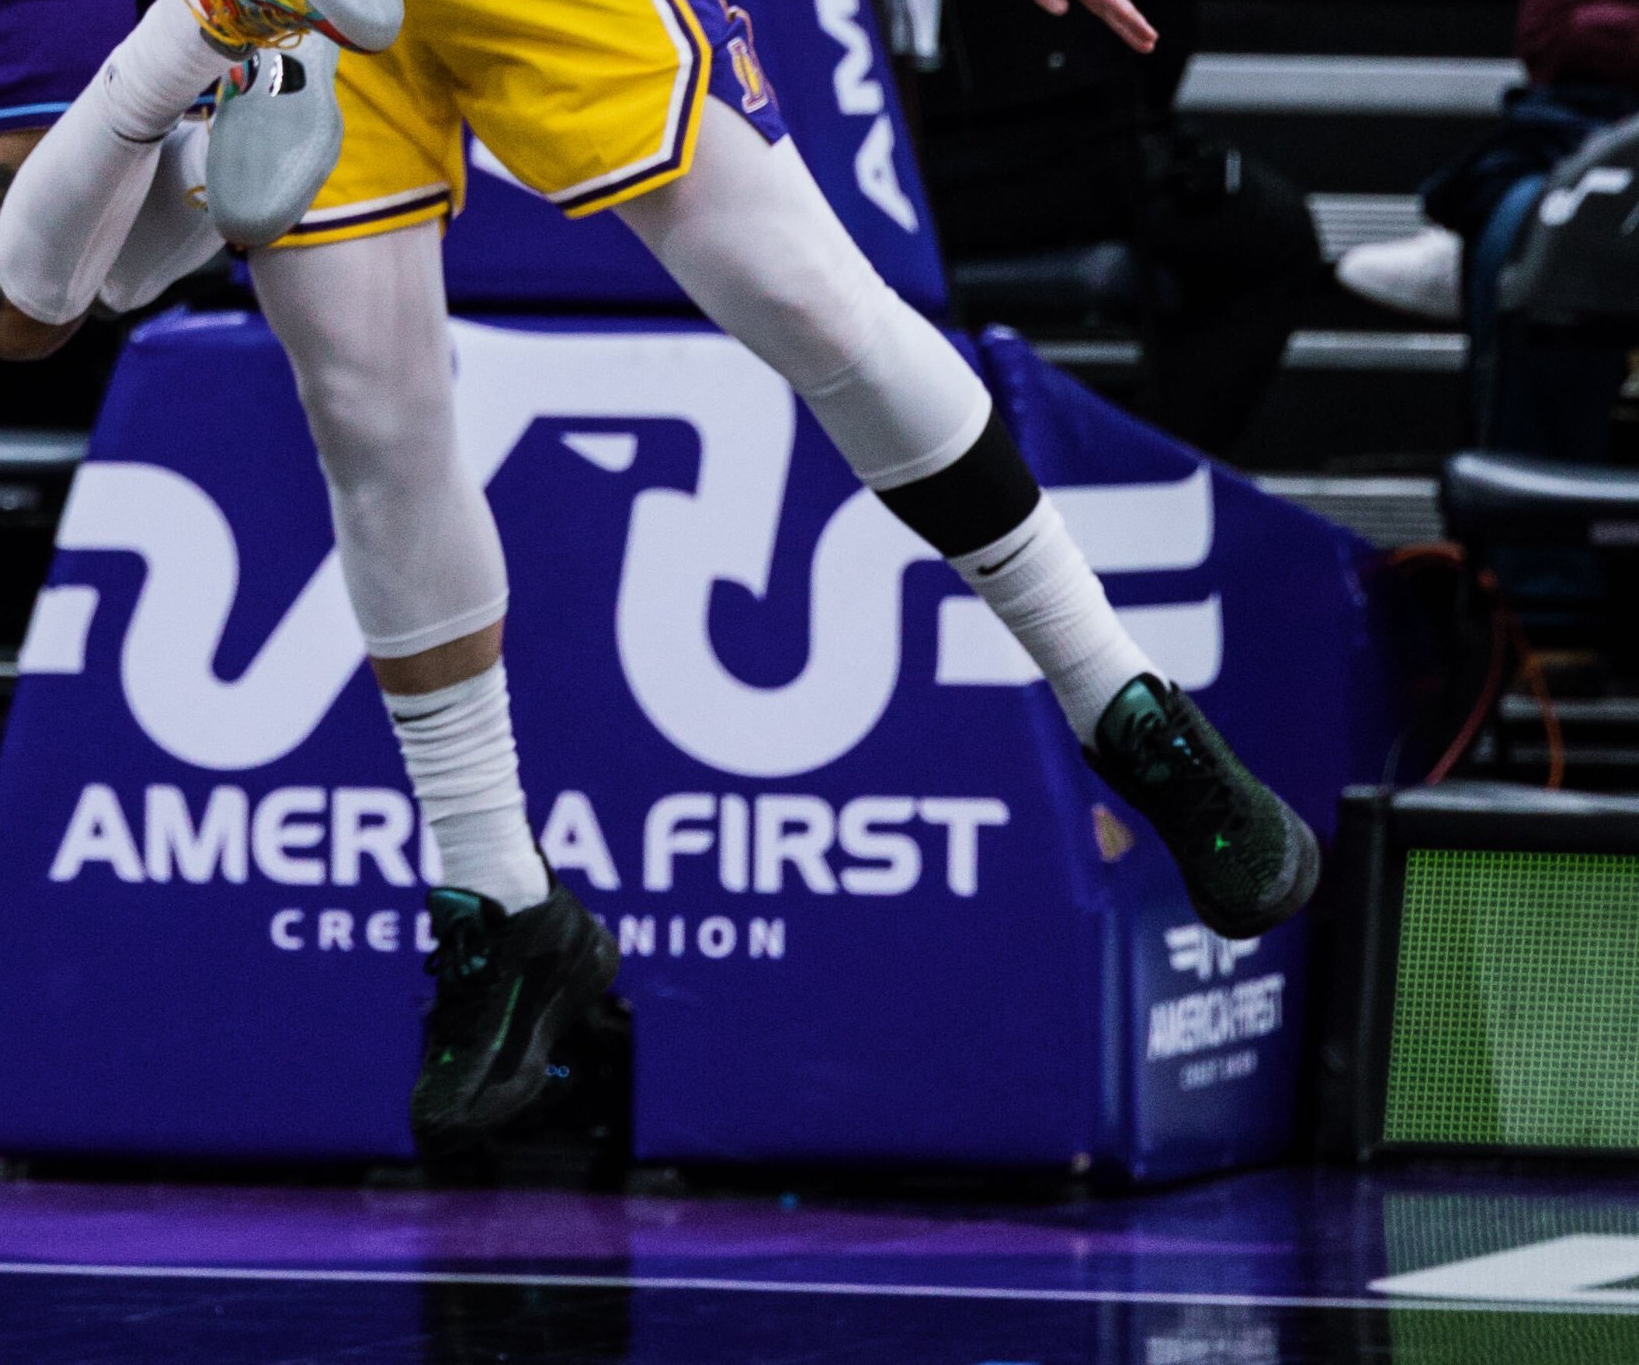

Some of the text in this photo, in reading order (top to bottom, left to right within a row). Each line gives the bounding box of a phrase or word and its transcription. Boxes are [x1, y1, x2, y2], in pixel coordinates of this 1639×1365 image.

[46, 781, 1013, 899] AMERIA FIRST
[597, 913, 787, 961] NION
